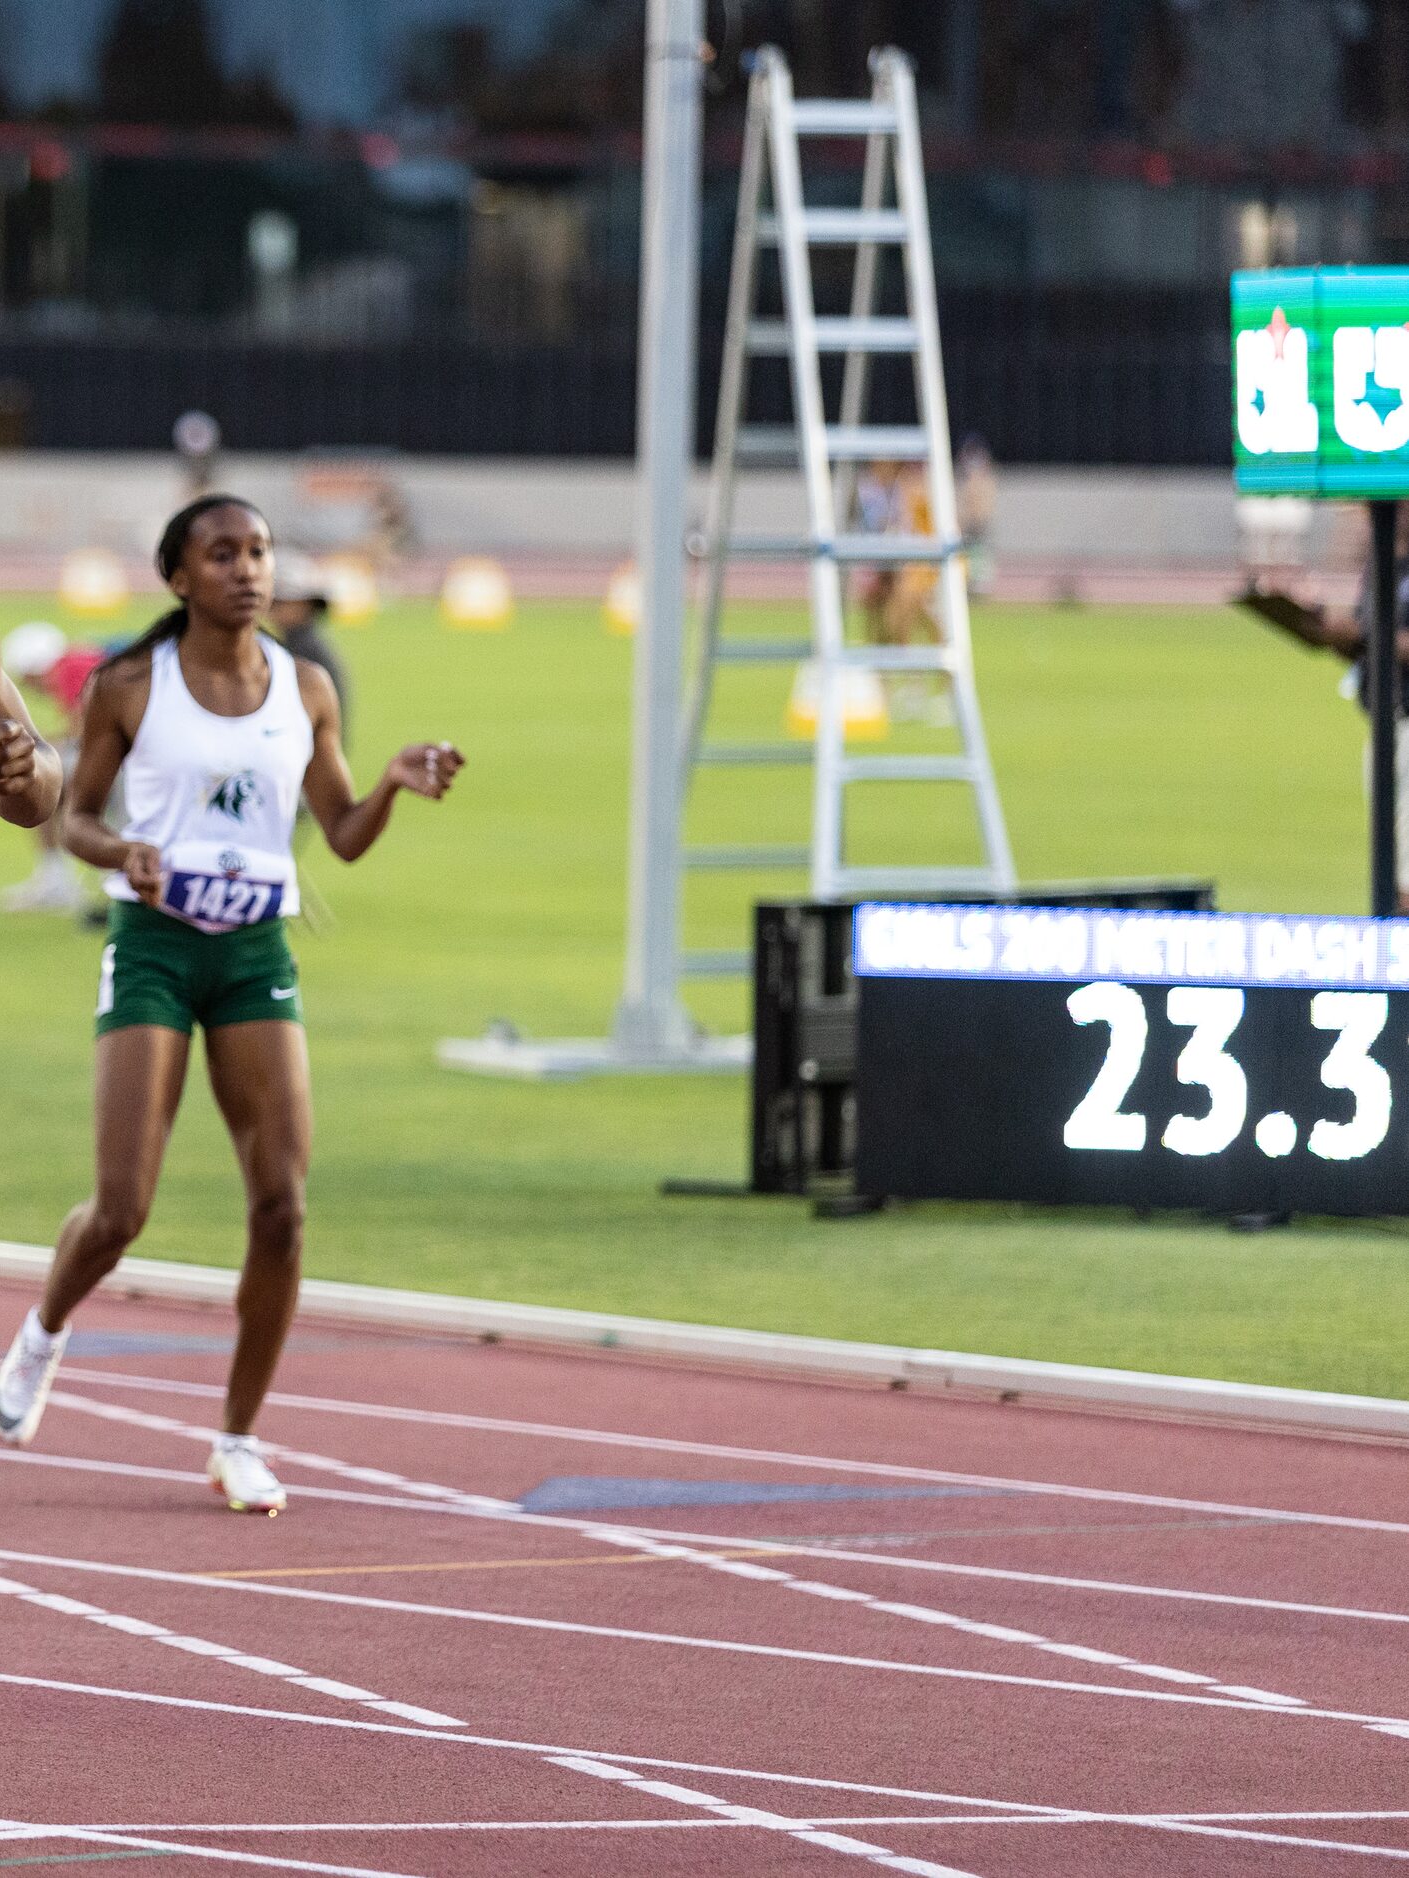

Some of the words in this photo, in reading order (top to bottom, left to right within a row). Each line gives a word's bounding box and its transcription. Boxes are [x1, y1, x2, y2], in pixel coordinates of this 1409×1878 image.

[184, 876, 272, 925] 1427
[1097, 917, 1243, 978] METER
[1256, 921, 1378, 982] DASH
[1063, 981, 1393, 1161] 23.3
